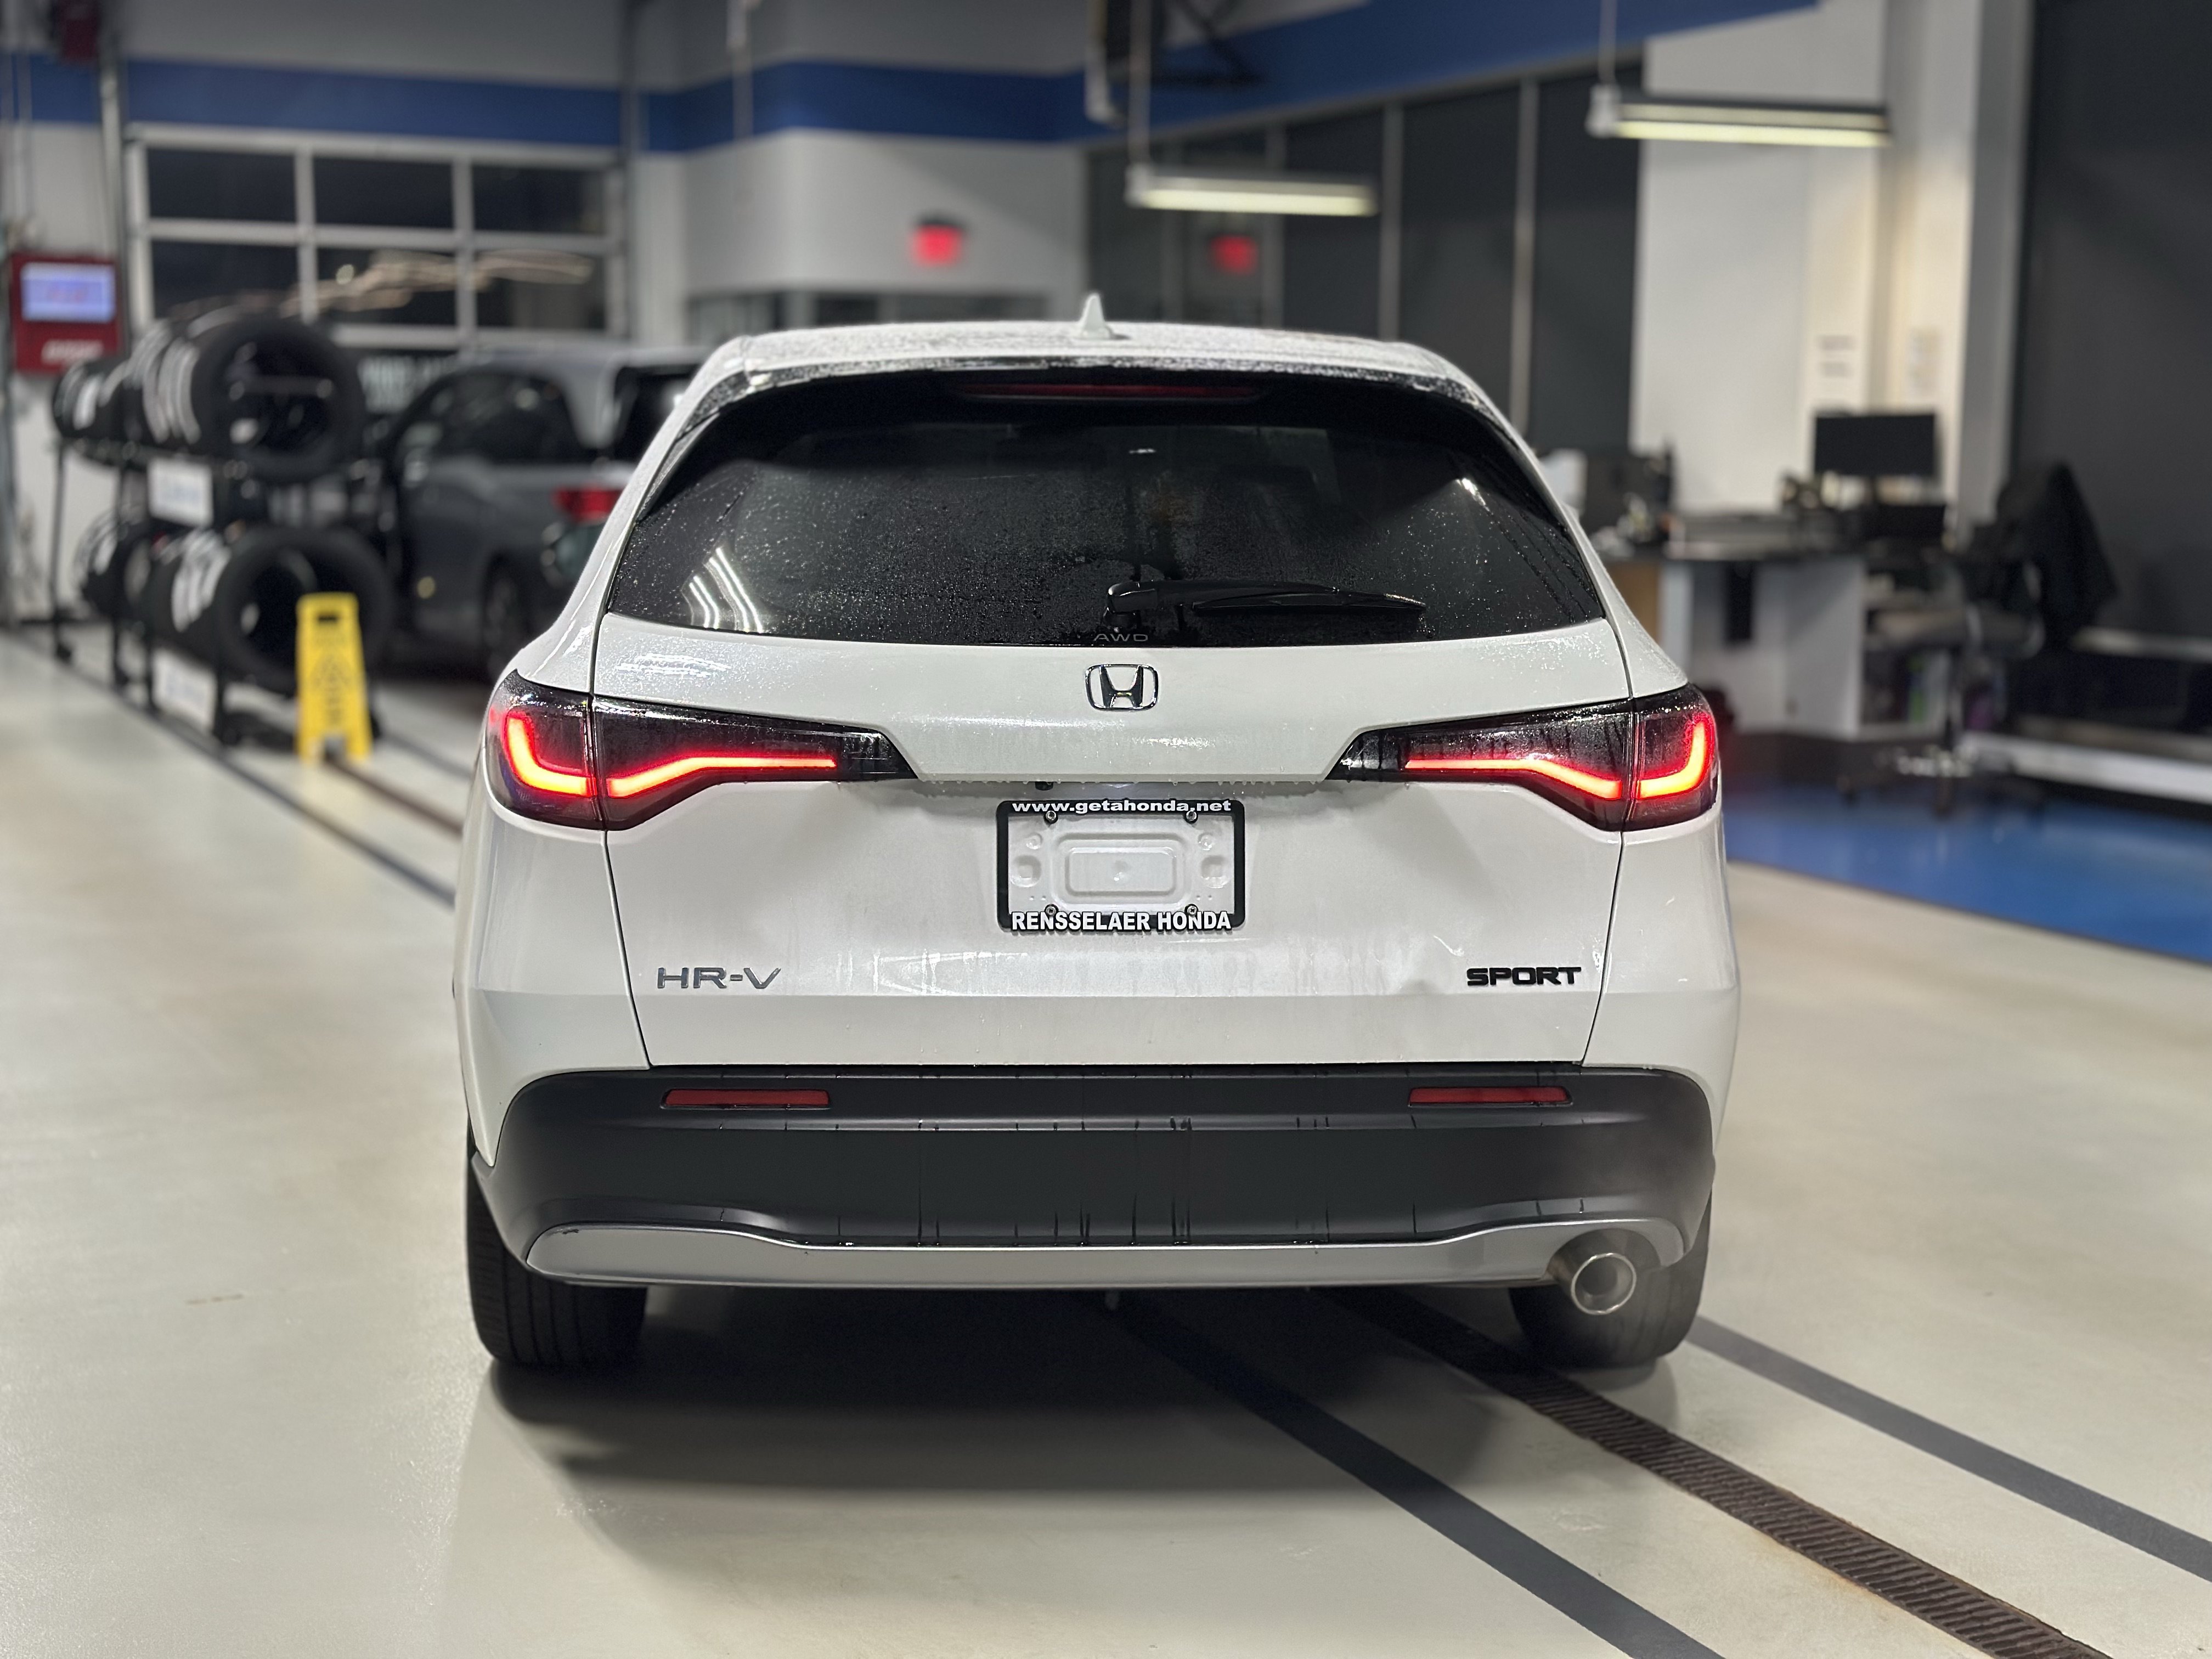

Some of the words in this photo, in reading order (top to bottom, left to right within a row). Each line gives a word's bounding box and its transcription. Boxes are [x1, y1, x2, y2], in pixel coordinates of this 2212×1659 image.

[1012, 800, 1232, 813] www.getahonda.net
[1012, 912, 1150, 930] RENSSELAER
[1158, 912, 1232, 930] HONDA
[657, 967, 781, 989] HR-V
[1466, 967, 1582, 986] SPORT
